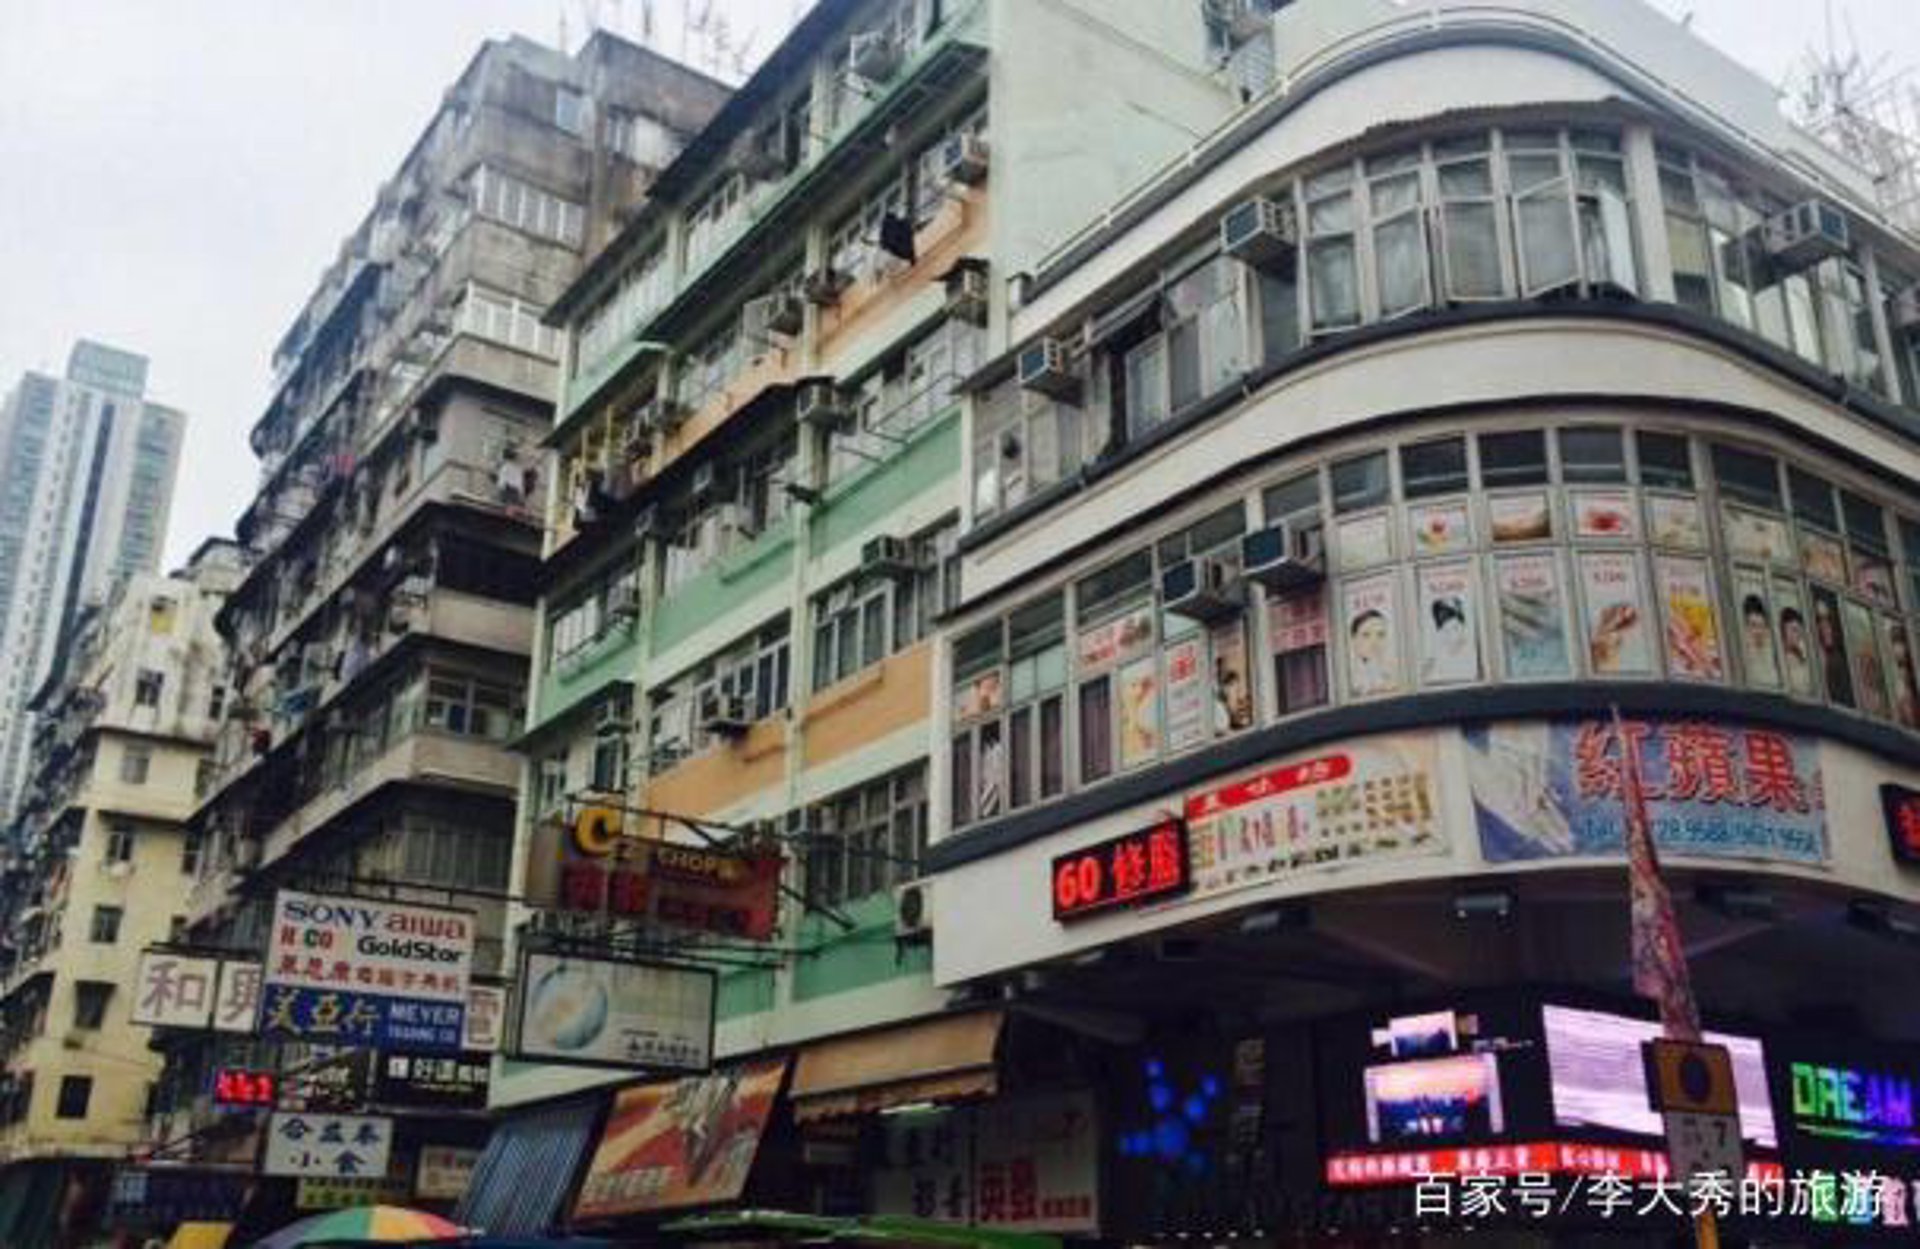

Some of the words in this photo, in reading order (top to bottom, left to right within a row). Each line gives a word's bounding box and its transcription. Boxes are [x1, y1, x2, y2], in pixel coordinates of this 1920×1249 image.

[1056, 857, 1100, 908] 60
[284, 902, 380, 929] SONY
[385, 912, 465, 941] aiwa
[390, 1001, 460, 1026] MEYER
